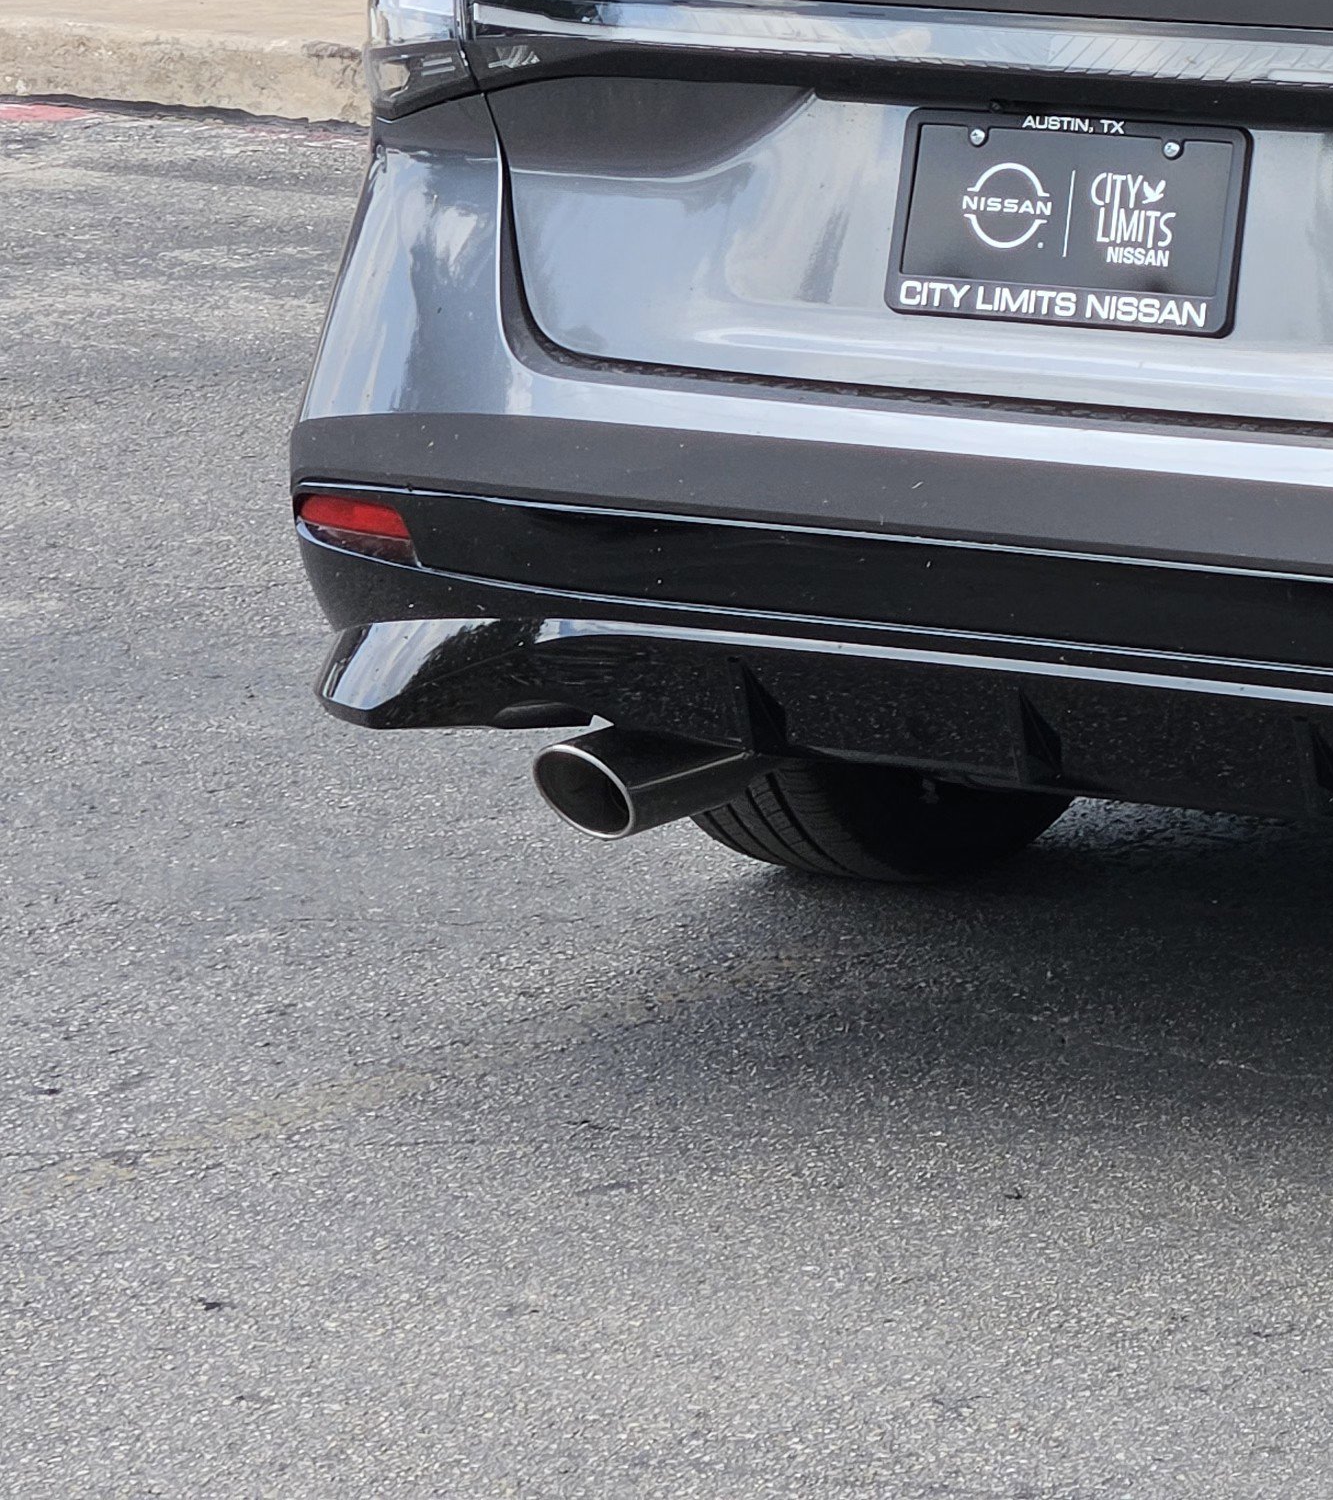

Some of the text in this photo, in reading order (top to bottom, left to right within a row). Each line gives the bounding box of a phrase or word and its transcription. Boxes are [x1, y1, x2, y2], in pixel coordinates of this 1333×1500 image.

[1022, 114, 1125, 135] AUSTIN, TX
[1090, 171, 1145, 207] CITY
[962, 195, 1052, 216] NISSAN
[1096, 206, 1176, 248] LIMITS
[1106, 246, 1170, 268] NISSAN
[899, 280, 1207, 328] CITY LIMITS NISSAN
